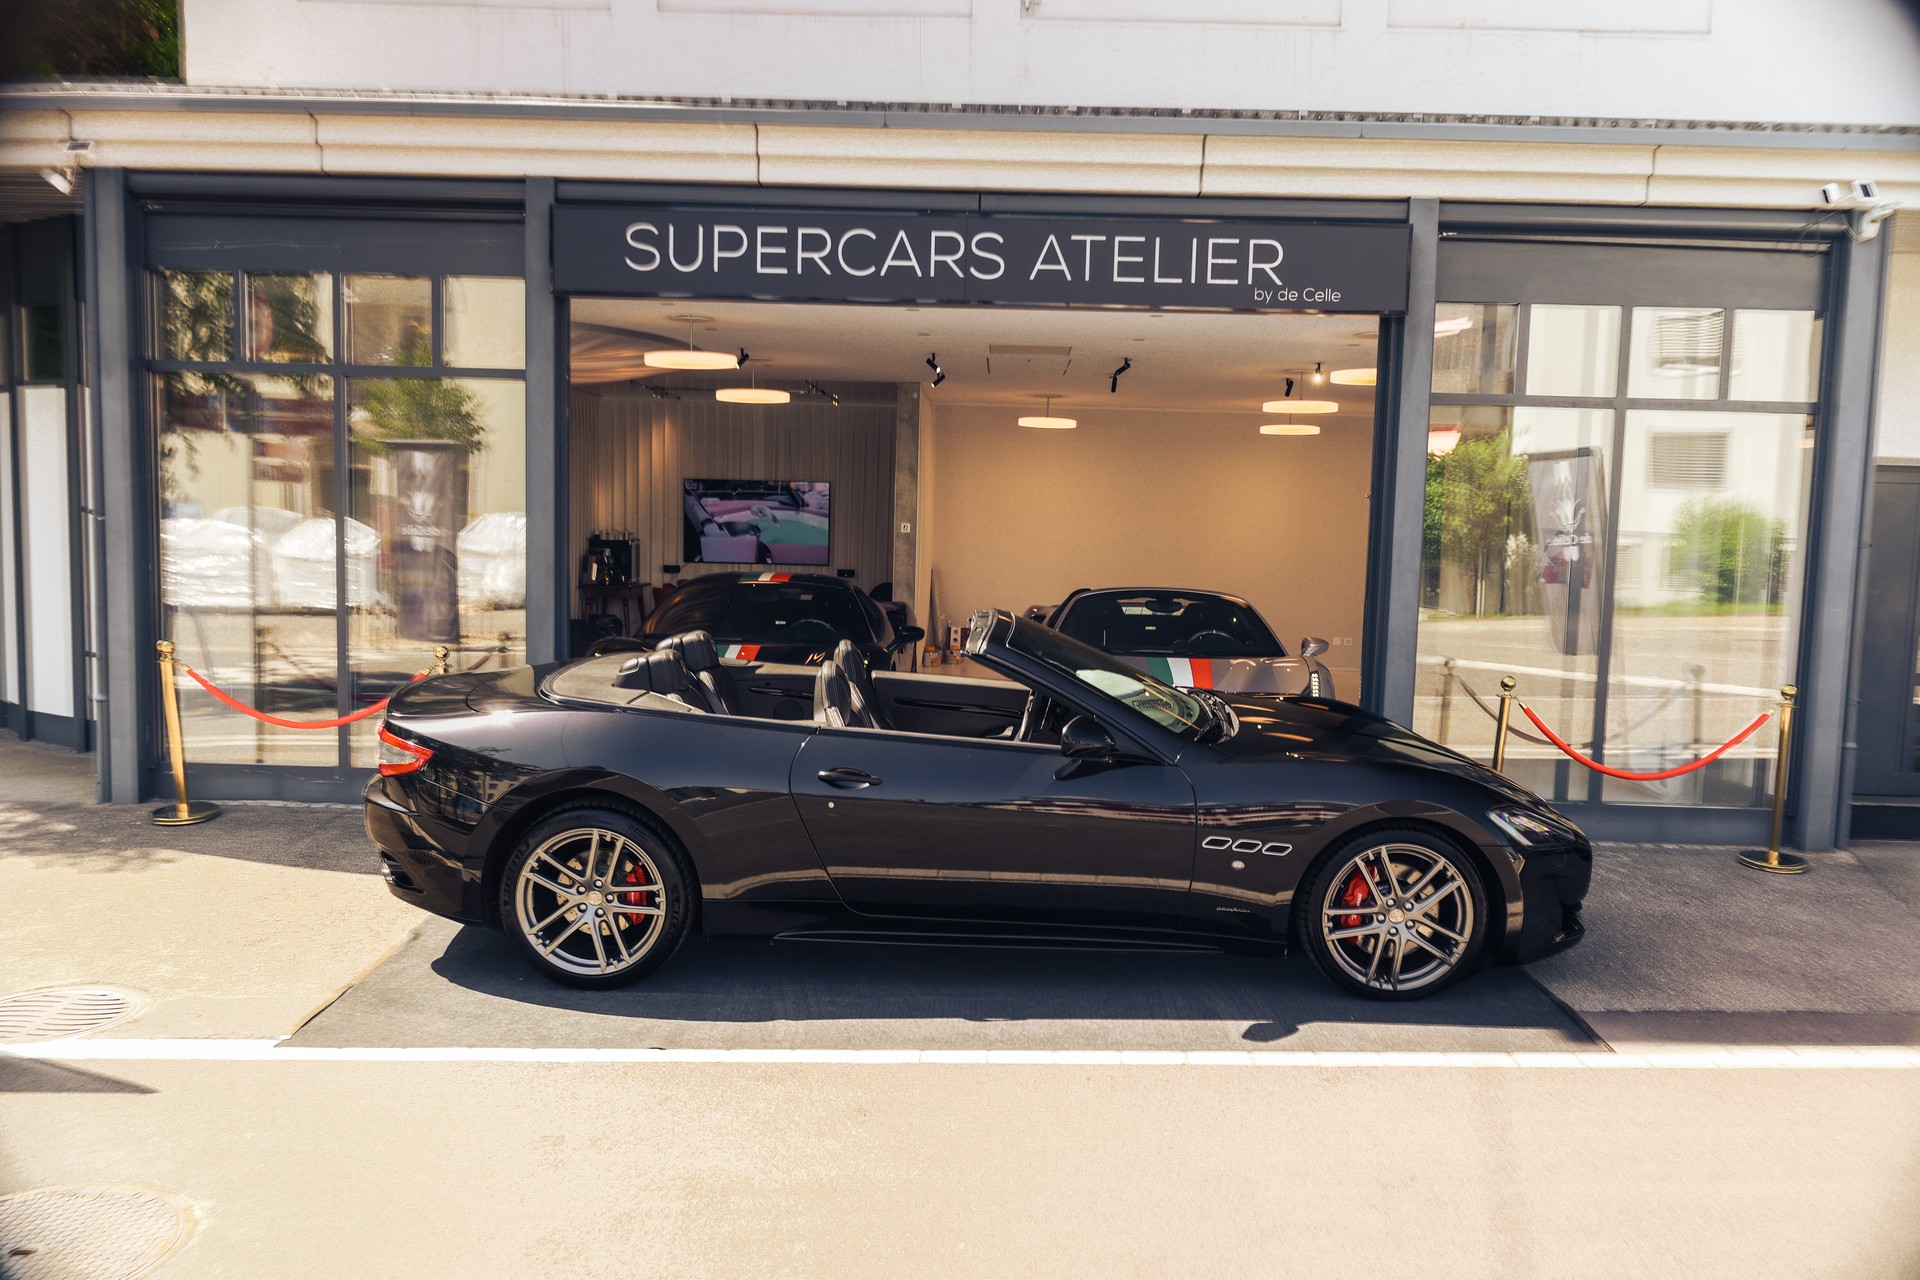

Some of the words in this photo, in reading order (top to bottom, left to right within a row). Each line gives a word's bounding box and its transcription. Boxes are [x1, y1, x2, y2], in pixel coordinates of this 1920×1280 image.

[624, 221, 1005, 280] SUPERCARS
[1029, 234, 1284, 286] ATELIER
[1254, 287, 1273, 304] by
[1278, 287, 1298, 301] de
[1303, 287, 1341, 302] Celle
